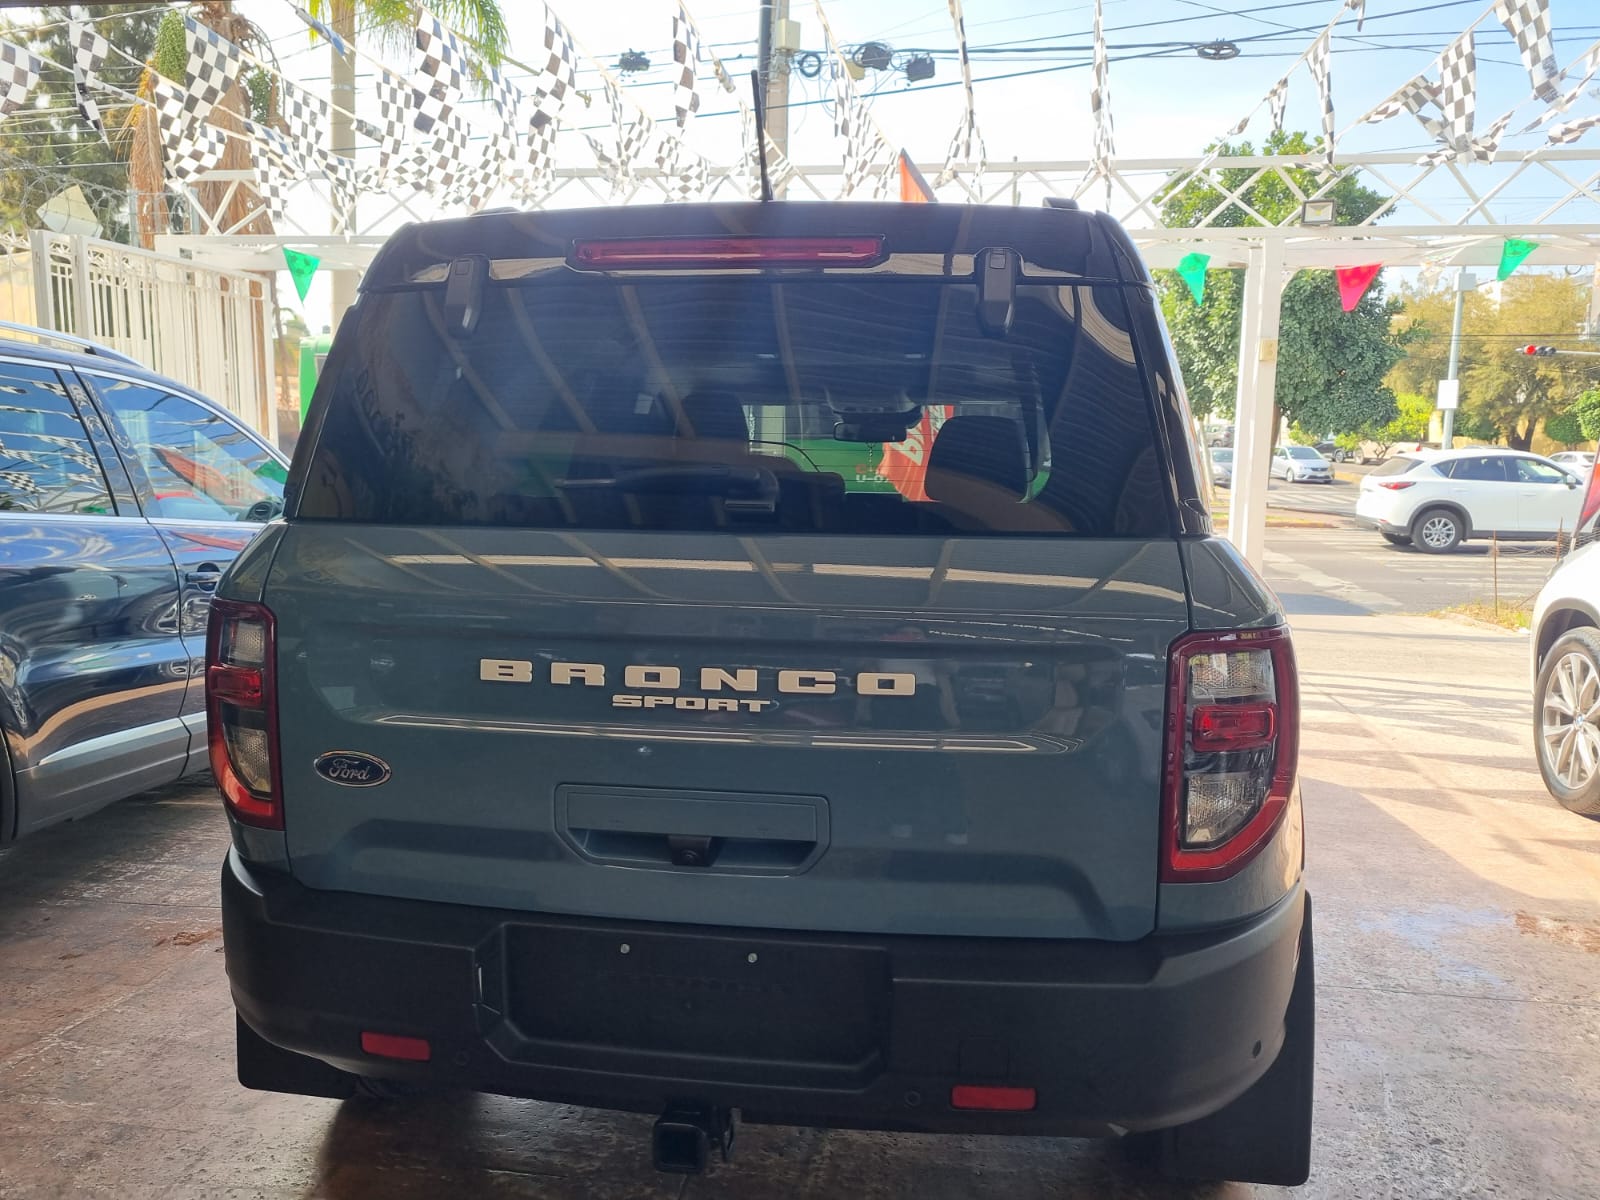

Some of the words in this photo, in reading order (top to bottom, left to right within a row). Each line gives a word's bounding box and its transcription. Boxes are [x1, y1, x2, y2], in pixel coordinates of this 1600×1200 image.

[479, 658, 917, 696] BRONCO
[611, 694, 772, 713] SPORT
[328, 758, 371, 780] Ford
